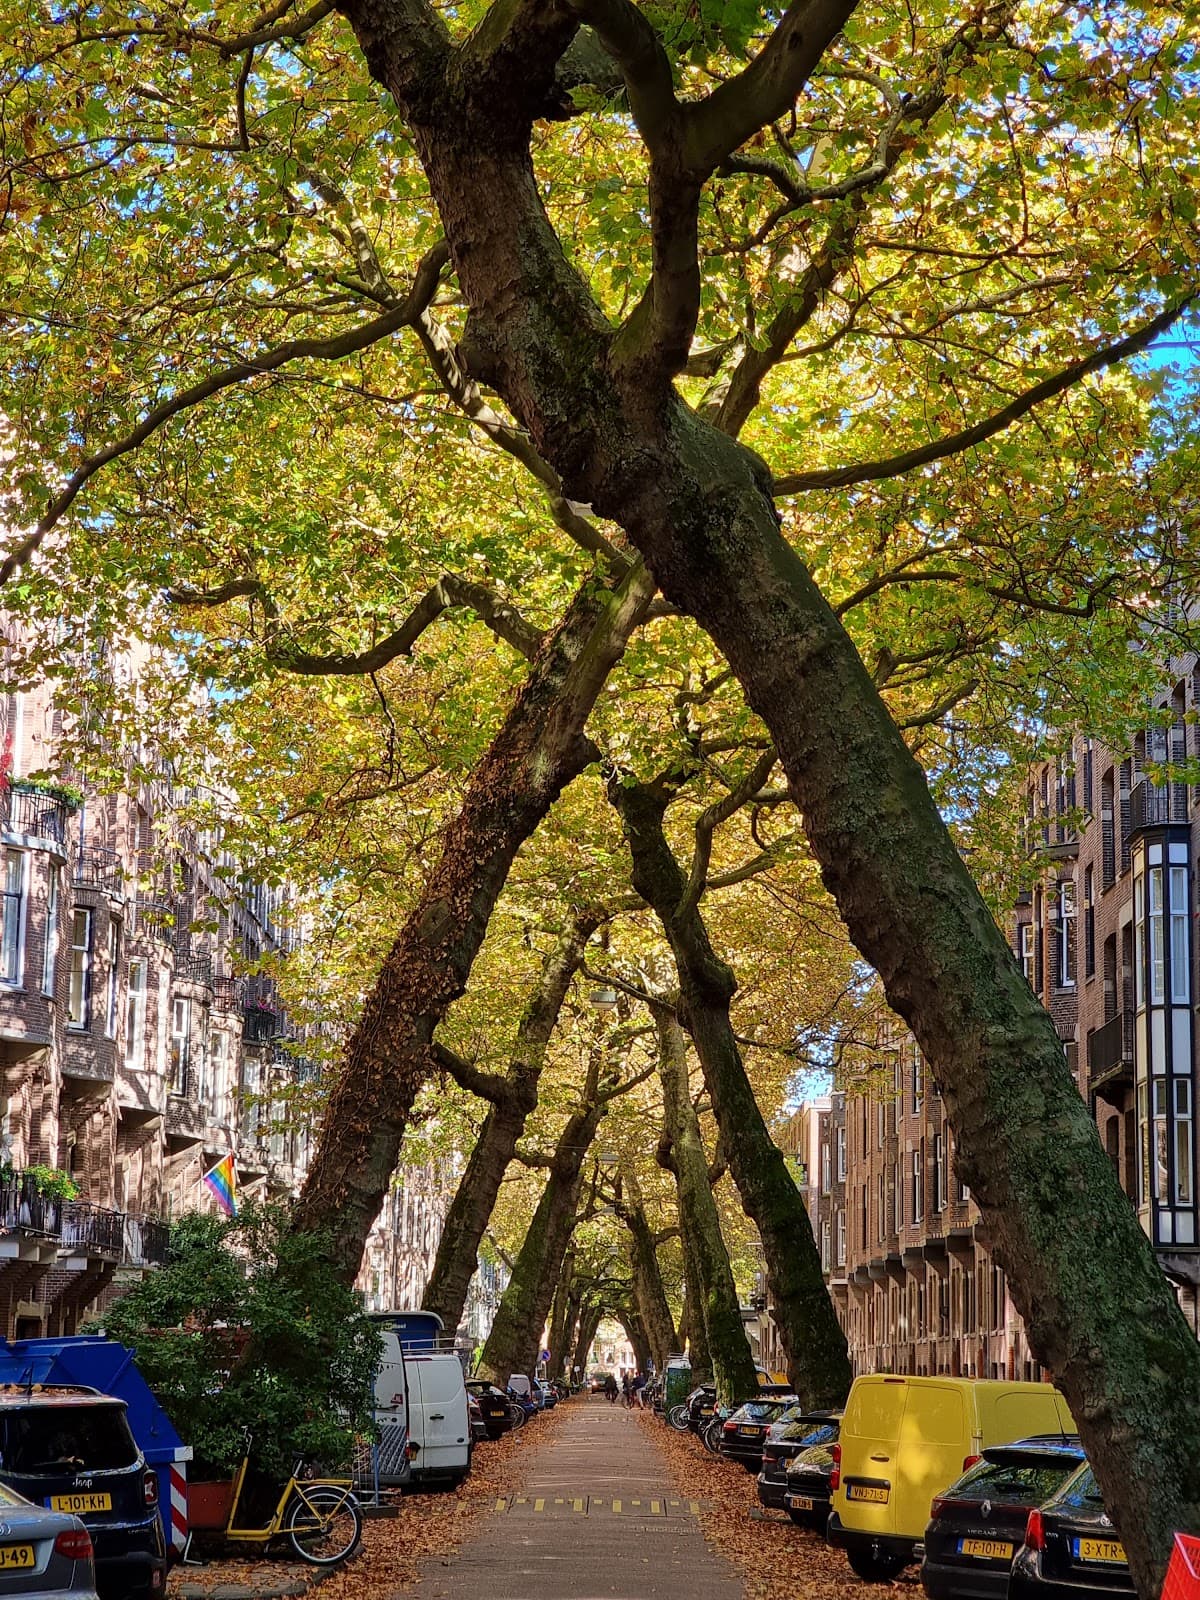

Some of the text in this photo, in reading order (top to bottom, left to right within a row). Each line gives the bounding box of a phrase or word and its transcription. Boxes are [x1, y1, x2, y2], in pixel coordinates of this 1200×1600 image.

[854, 1487, 884, 1500] VNJ-71-S
[58, 1495, 105, 1511] L-101-KH
[968, 1541, 1007, 1555] TF-101-H
[1084, 1542, 1125, 1558] 3-XTR-
